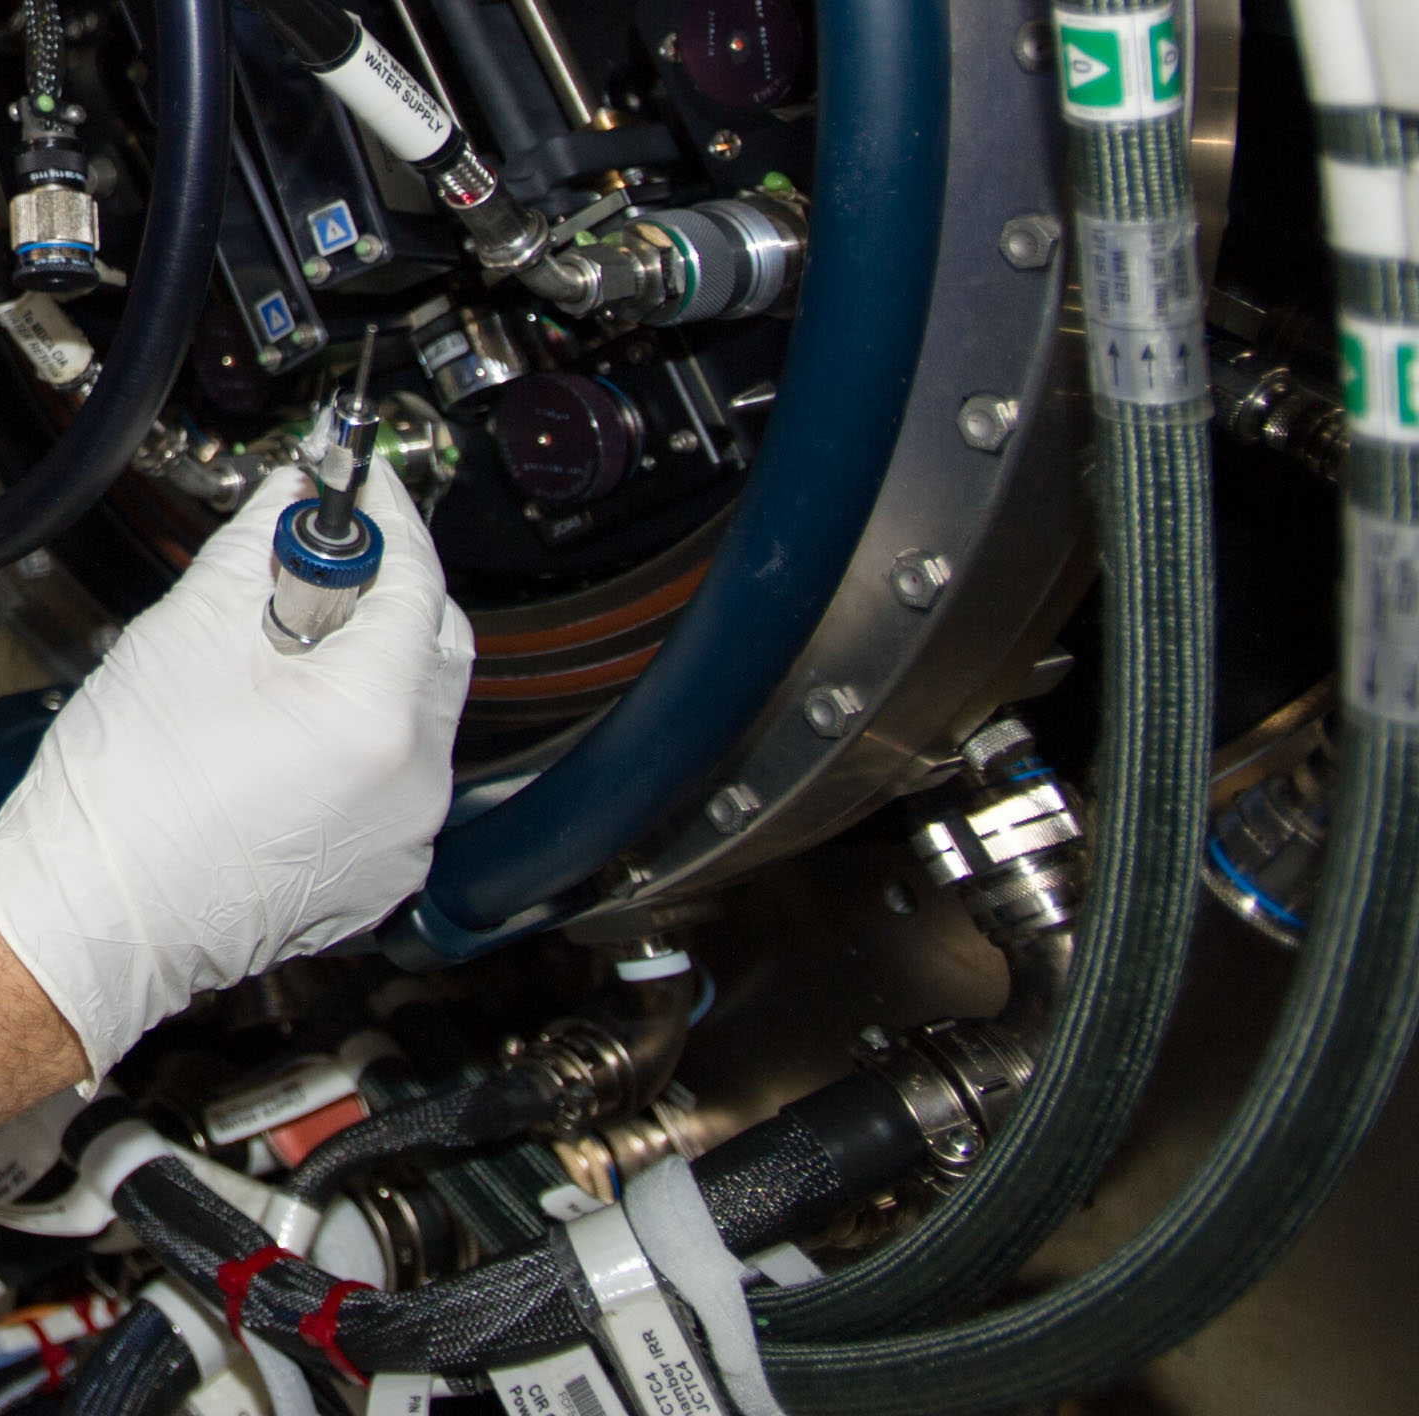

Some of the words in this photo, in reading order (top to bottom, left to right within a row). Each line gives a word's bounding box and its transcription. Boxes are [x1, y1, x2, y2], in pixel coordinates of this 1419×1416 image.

[364, 50, 403, 95] WATER
[401, 89, 444, 134] SUPPLY
[389, 60, 421, 97] MDCA
[642, 1328, 665, 1360] IRR
[528, 1383, 550, 1413] CIR
[674, 1360, 711, 1413] JCTC4
